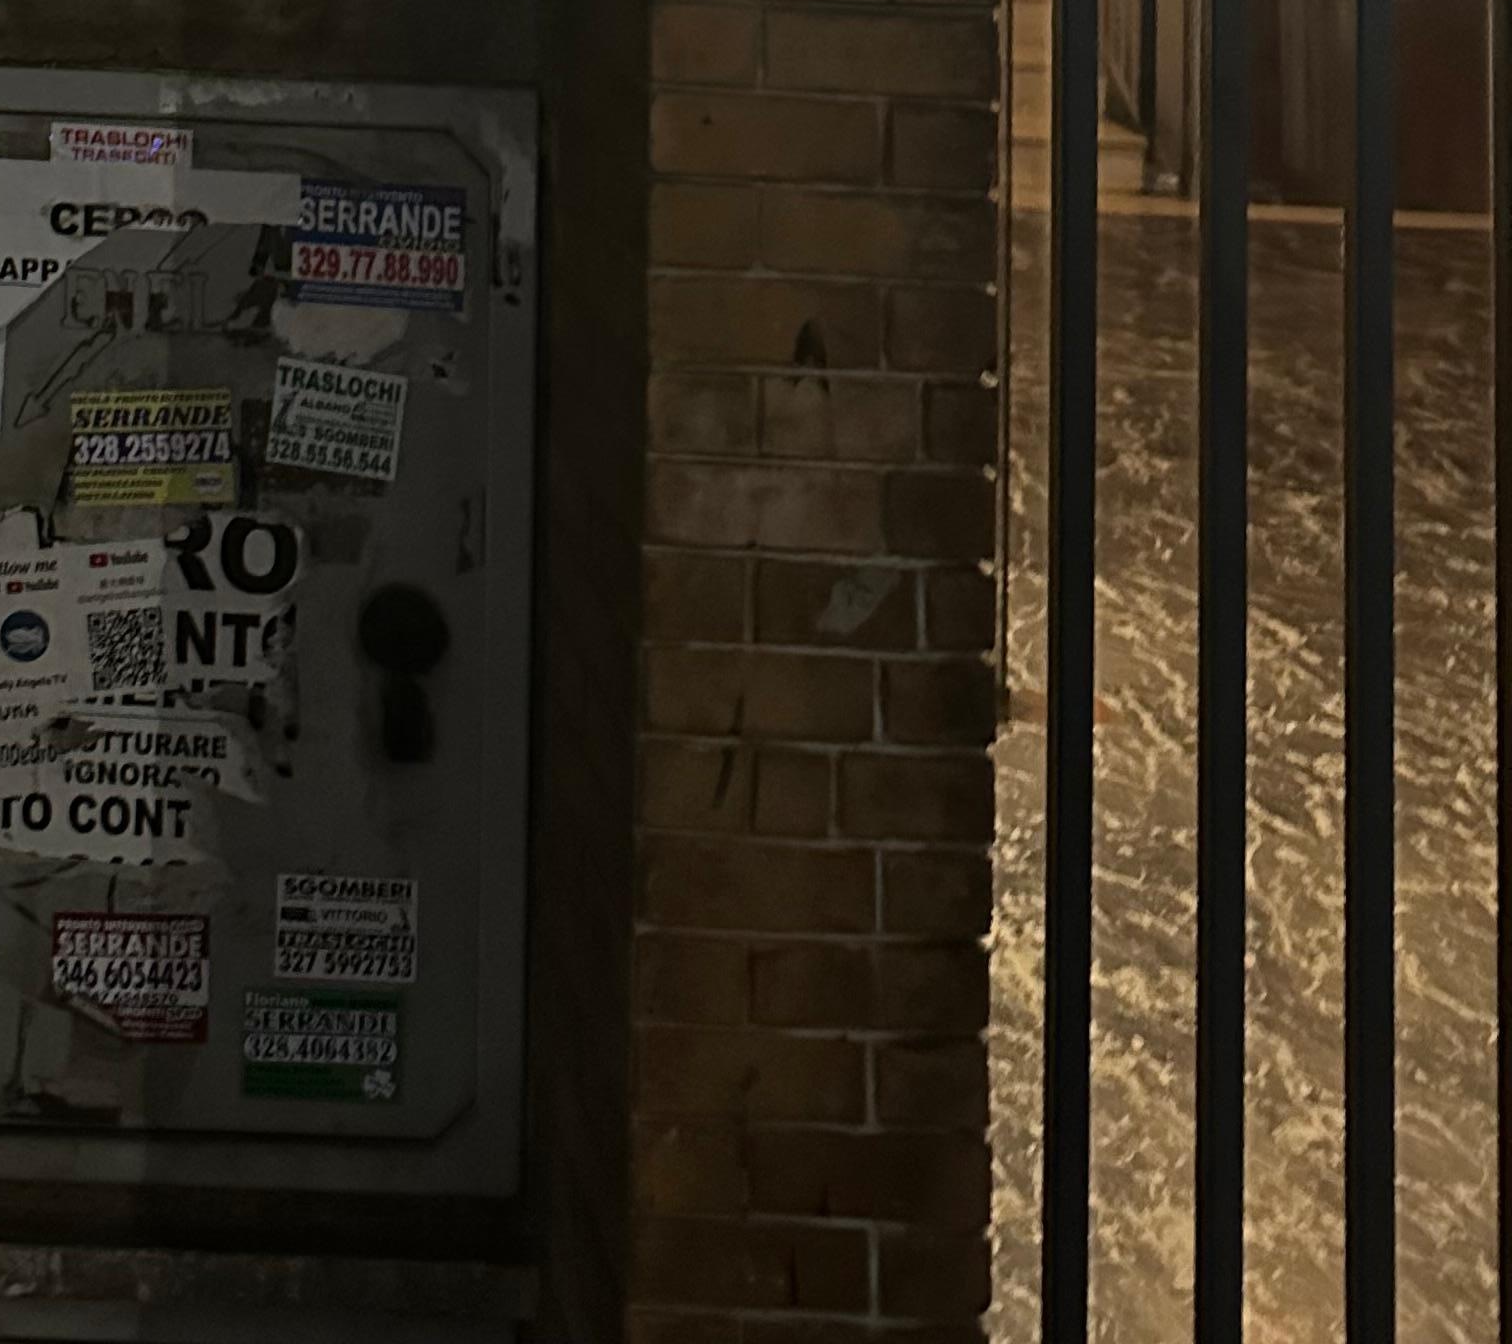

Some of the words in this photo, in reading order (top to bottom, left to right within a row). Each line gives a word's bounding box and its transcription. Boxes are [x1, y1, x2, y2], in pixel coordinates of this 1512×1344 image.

[300, 196, 462, 240] SERRANDE
[298, 246, 458, 286] 329.77.88.990
[279, 364, 402, 403] TRASLOCHI
[74, 405, 231, 428] SERRANDE
[74, 431, 231, 464] 328.2559274
[35, 560, 58, 572] me
[285, 878, 411, 899] SGOMBERI
[57, 931, 203, 958] SERRANDE
[58, 958, 98, 988] 346
[104, 960, 202, 993] 6054423
